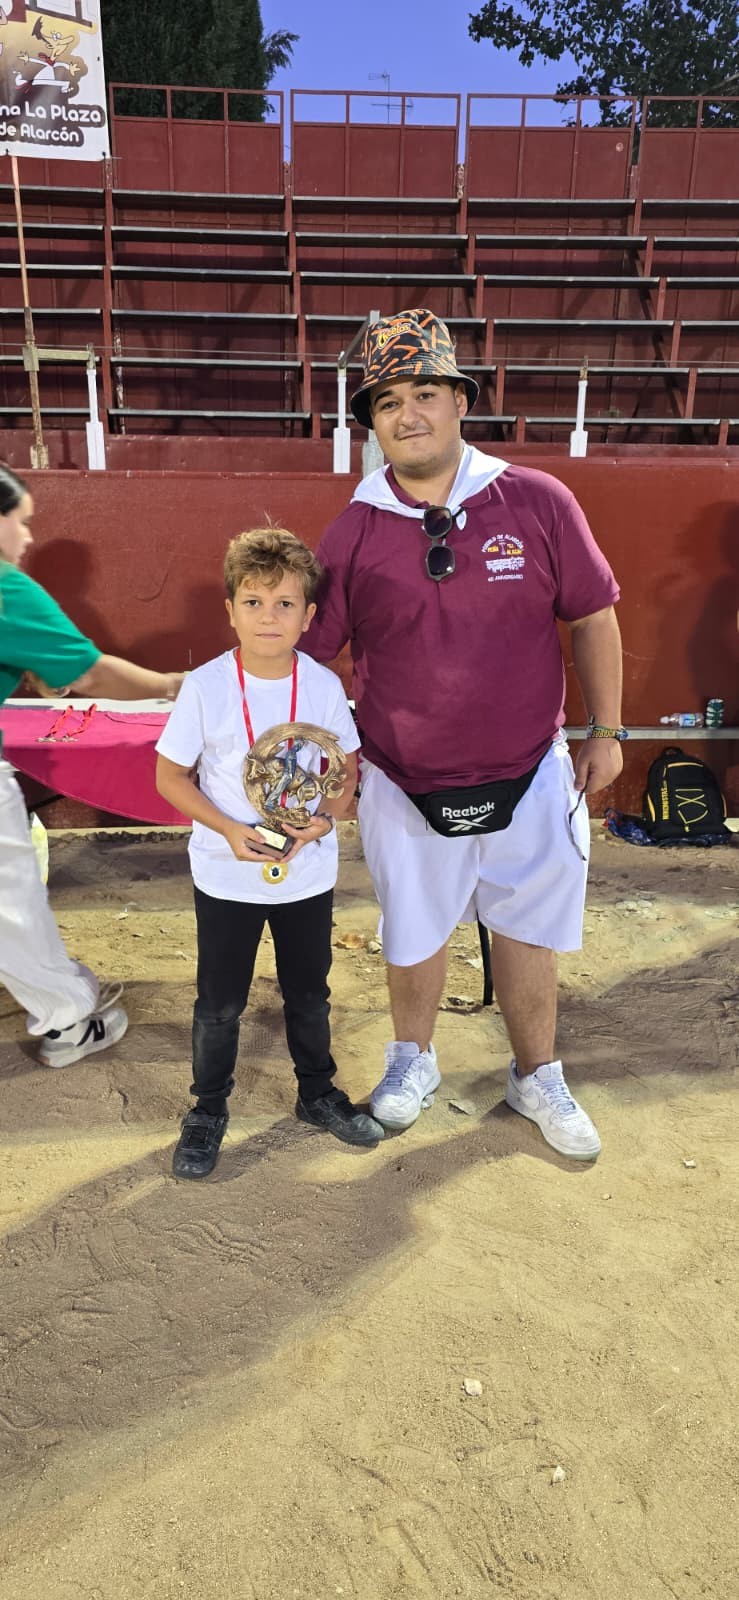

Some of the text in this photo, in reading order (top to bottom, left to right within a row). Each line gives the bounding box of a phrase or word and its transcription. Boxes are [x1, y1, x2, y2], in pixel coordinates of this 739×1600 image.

[25, 101, 47, 119] La
[50, 104, 101, 123] Plaza
[0, 122, 80, 143] de Alarcón
[442, 801, 496, 819] Reebok
